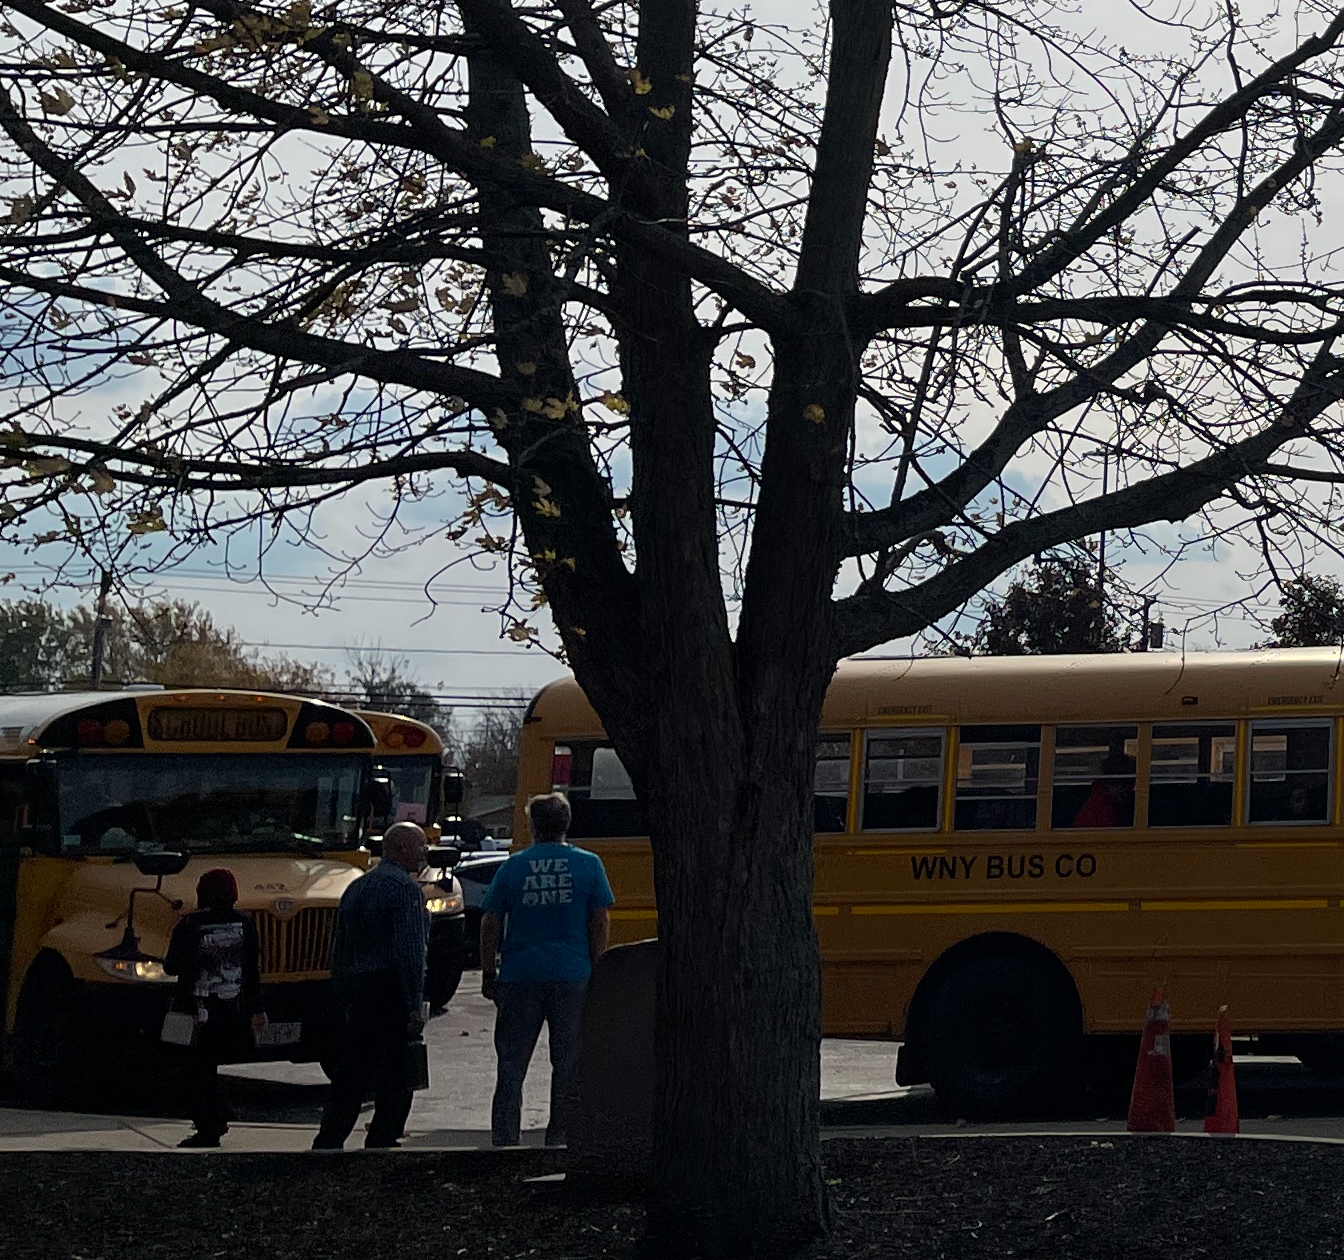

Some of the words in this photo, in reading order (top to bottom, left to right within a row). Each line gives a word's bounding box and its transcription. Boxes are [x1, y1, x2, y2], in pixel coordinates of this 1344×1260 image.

[528, 858, 569, 873] WE
[911, 855, 978, 880] WNY
[986, 854, 1045, 879] BUS
[1055, 853, 1097, 878] CO
[522, 873, 573, 890] ARE
[522, 889, 573, 906] ONE
